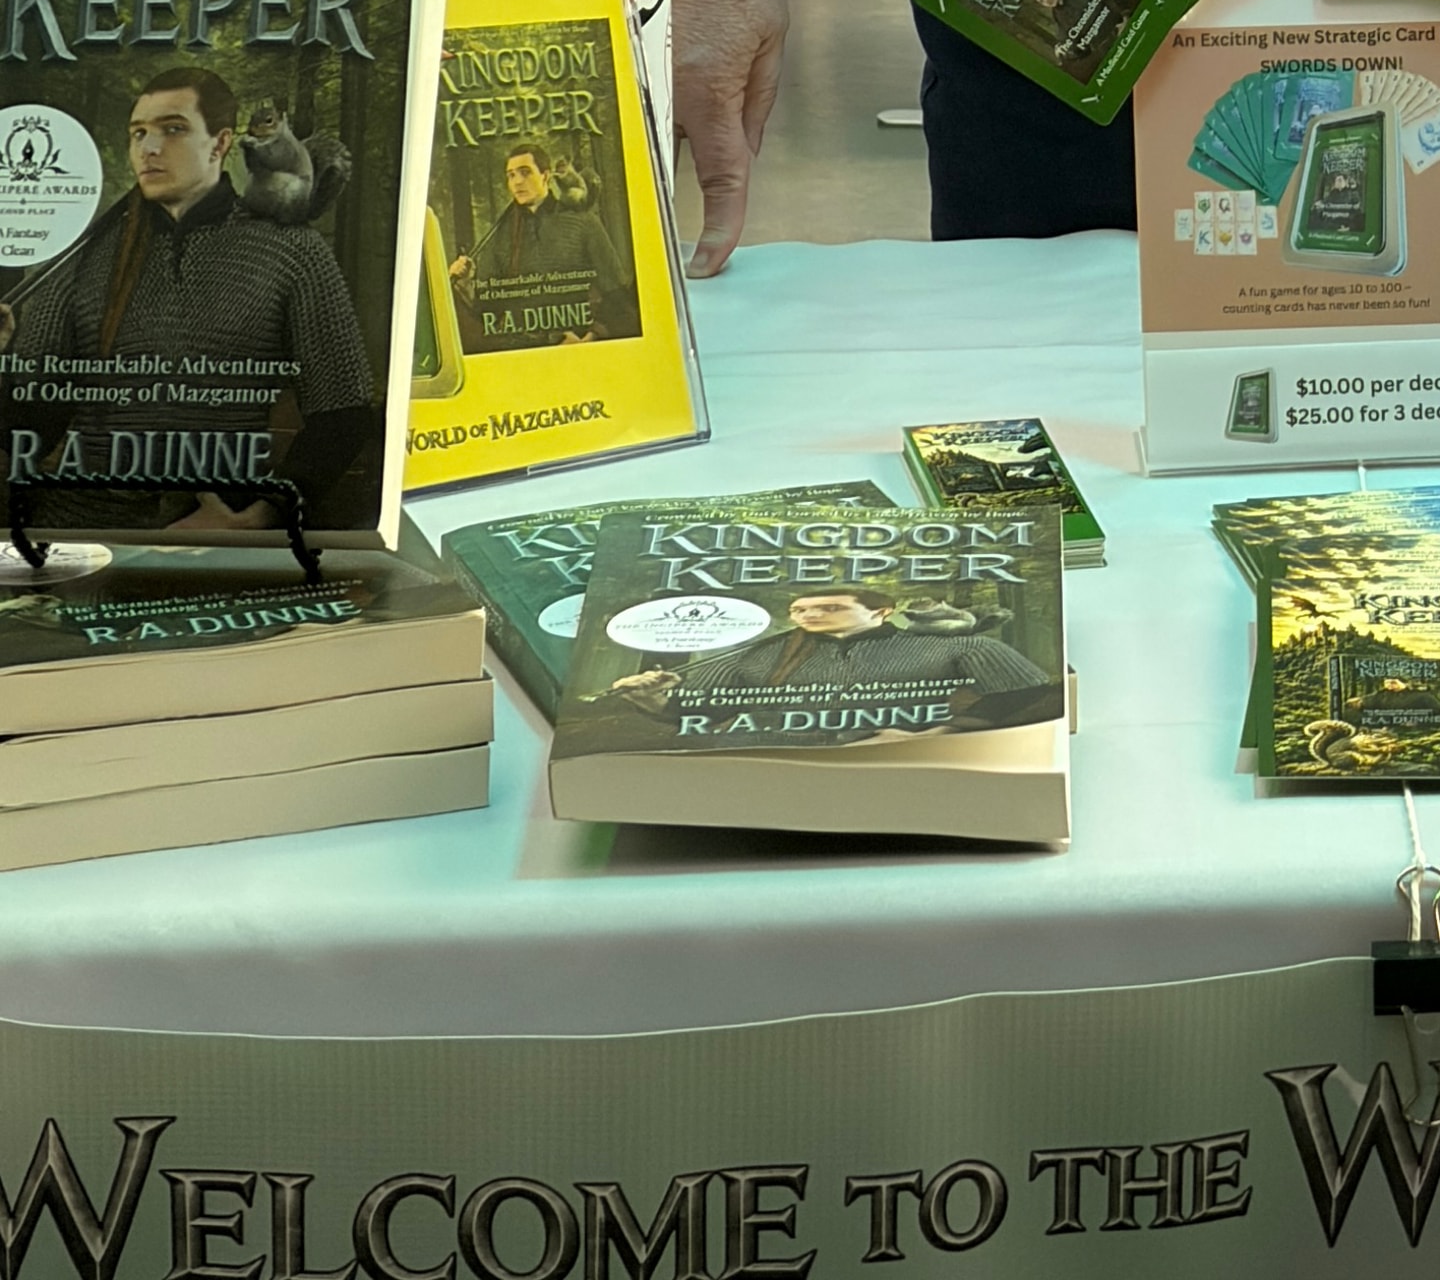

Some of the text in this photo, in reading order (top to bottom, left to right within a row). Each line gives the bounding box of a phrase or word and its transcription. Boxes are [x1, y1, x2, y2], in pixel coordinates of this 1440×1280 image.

[1172, 33, 1196, 49] An
[1201, 30, 1268, 50] Exciting
[1272, 29, 1310, 46] New
[1314, 28, 1391, 50] Strategic
[1395, 26, 1435, 43] Card
[1260, 57, 1403, 75] SWORDS DOWN!
[440, 89, 603, 149] KEEPER
[43, 184, 98, 196] AWARDS
[525, 302, 594, 332] DUNNE
[0, 353, 301, 375] The Remarkable Adventures
[12, 381, 281, 406] of Odemog of Mazgamor
[1296, 376, 1365, 397] $10.00
[1371, 376, 1404, 396] per
[489, 399, 612, 441] MAZGAMOR
[1286, 405, 1354, 427] $25.00
[1360, 405, 1388, 423] for
[1394, 405, 1405, 421] 3
[639, 521, 1036, 558] KINGDOM
[654, 553, 1028, 592] KEEPER
[188, 599, 362, 636] DUNNE
[783, 703, 954, 733] DUNNE
[845, 1159, 1008, 1264] TO
[1029, 1129, 1252, 1237] THE
